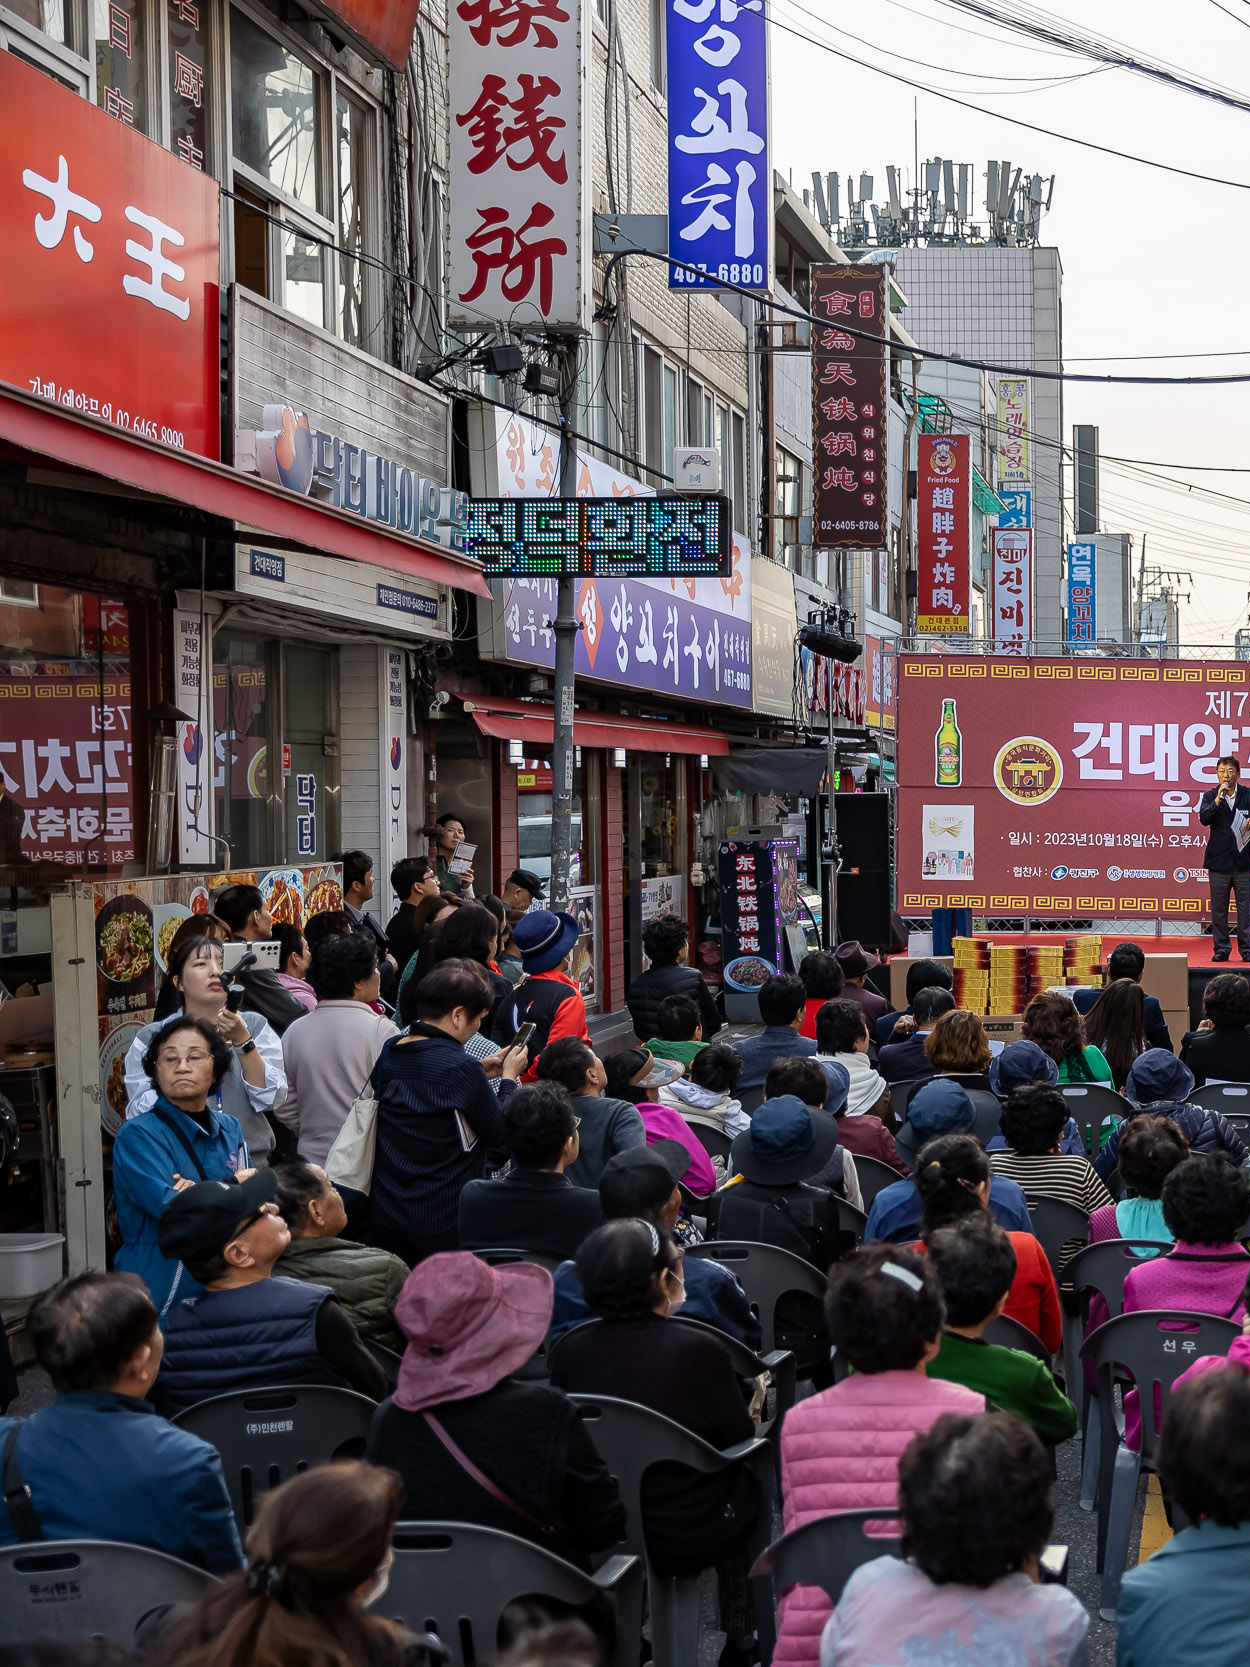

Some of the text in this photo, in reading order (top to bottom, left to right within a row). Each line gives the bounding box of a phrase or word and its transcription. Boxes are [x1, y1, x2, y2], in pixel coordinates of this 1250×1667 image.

[1005, 399, 1024, 469] 노래연습장
[861, 403, 878, 508] 식위천식당
[821, 521, 880, 531] 02-6405-8786
[932, 487, 955, 609] 趙胖子炸肉
[254, 556, 283, 577] 건대직영점
[927, 617, 960, 625] 건대본점
[1071, 586, 1092, 640] 양꼬치
[506, 603, 558, 650] 선두주
[184, 638, 199, 652] 전용
[611, 583, 721, 693] 양꼬치구이
[1008, 831, 1032, 846] 일시
[1044, 833, 1164, 848] 2023년10월18일(수)
[1013, 866, 1042, 878] 협찬사
[1069, 869, 1099, 878] 광진구
[735, 855, 761, 952] 东北铁锅炖
[1162, 1339, 1197, 1354] 선우
[247, 1420, 293, 1435] (주)인천렌탈
